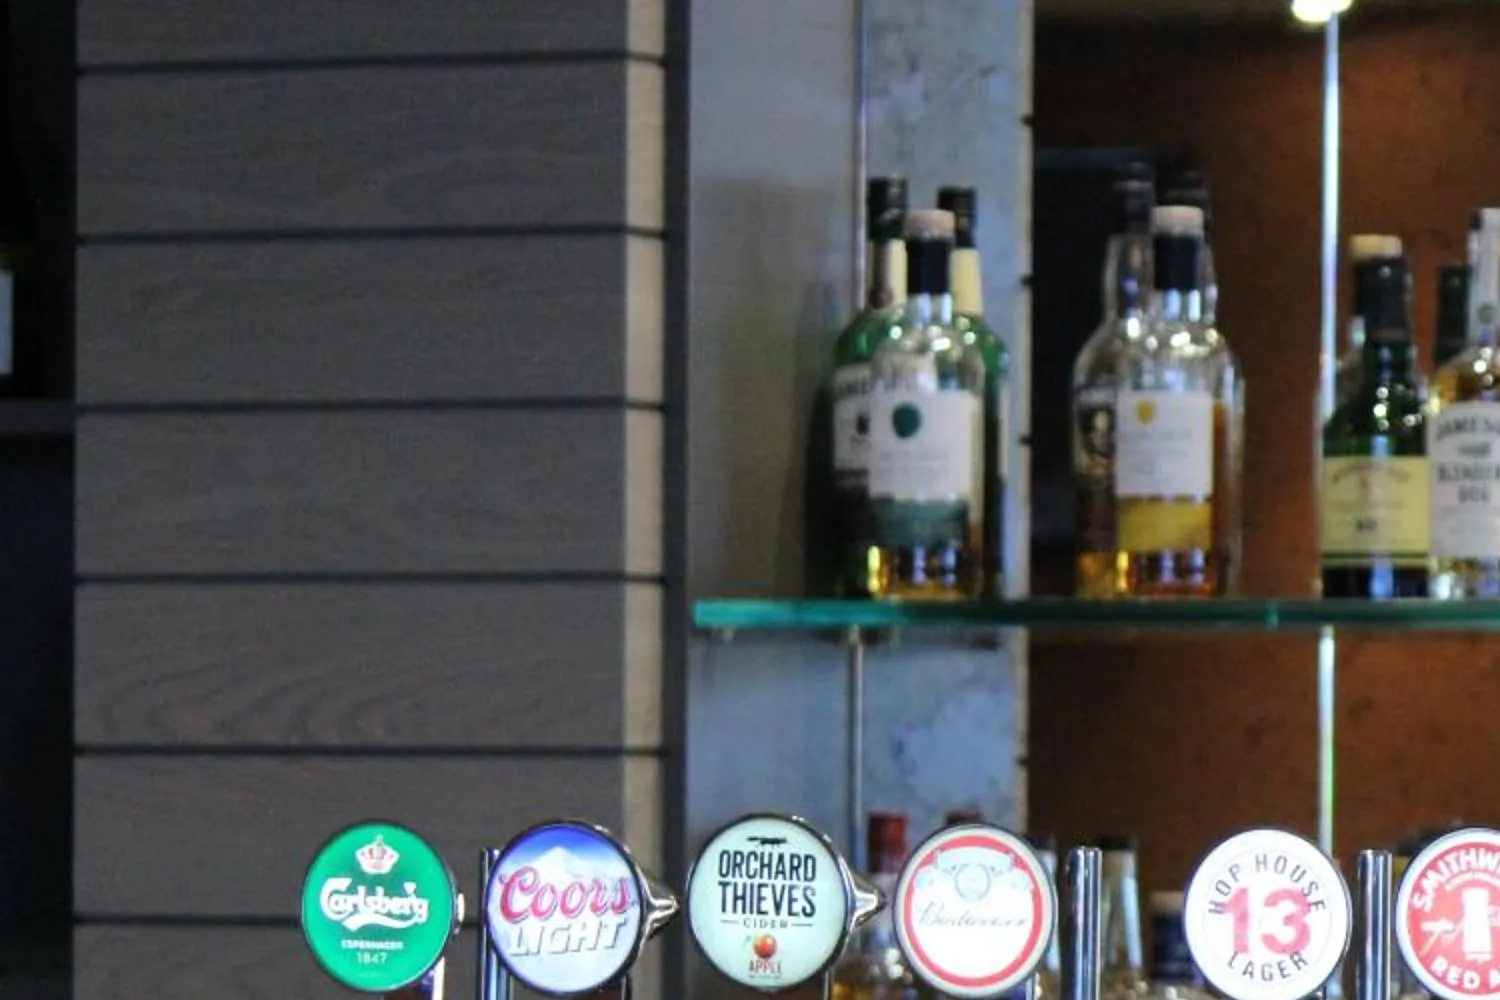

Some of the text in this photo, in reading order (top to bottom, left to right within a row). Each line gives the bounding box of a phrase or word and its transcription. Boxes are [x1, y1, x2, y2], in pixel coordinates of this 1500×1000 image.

[718, 849, 816, 881] ORCHARD
[499, 865, 630, 924] Coors
[718, 880, 816, 918] THIEVES
[1208, 853, 1326, 915] HOP HOUSE
[320, 877, 430, 932] Carlsberg
[1225, 887, 1311, 955] 13
[508, 918, 629, 957] LIGHT
[743, 917, 789, 929] CIDER
[357, 952, 388, 965] 1847
[748, 959, 783, 975] APPLE
[1227, 951, 1309, 982] LAGER
[1431, 955, 1481, 990] RED
